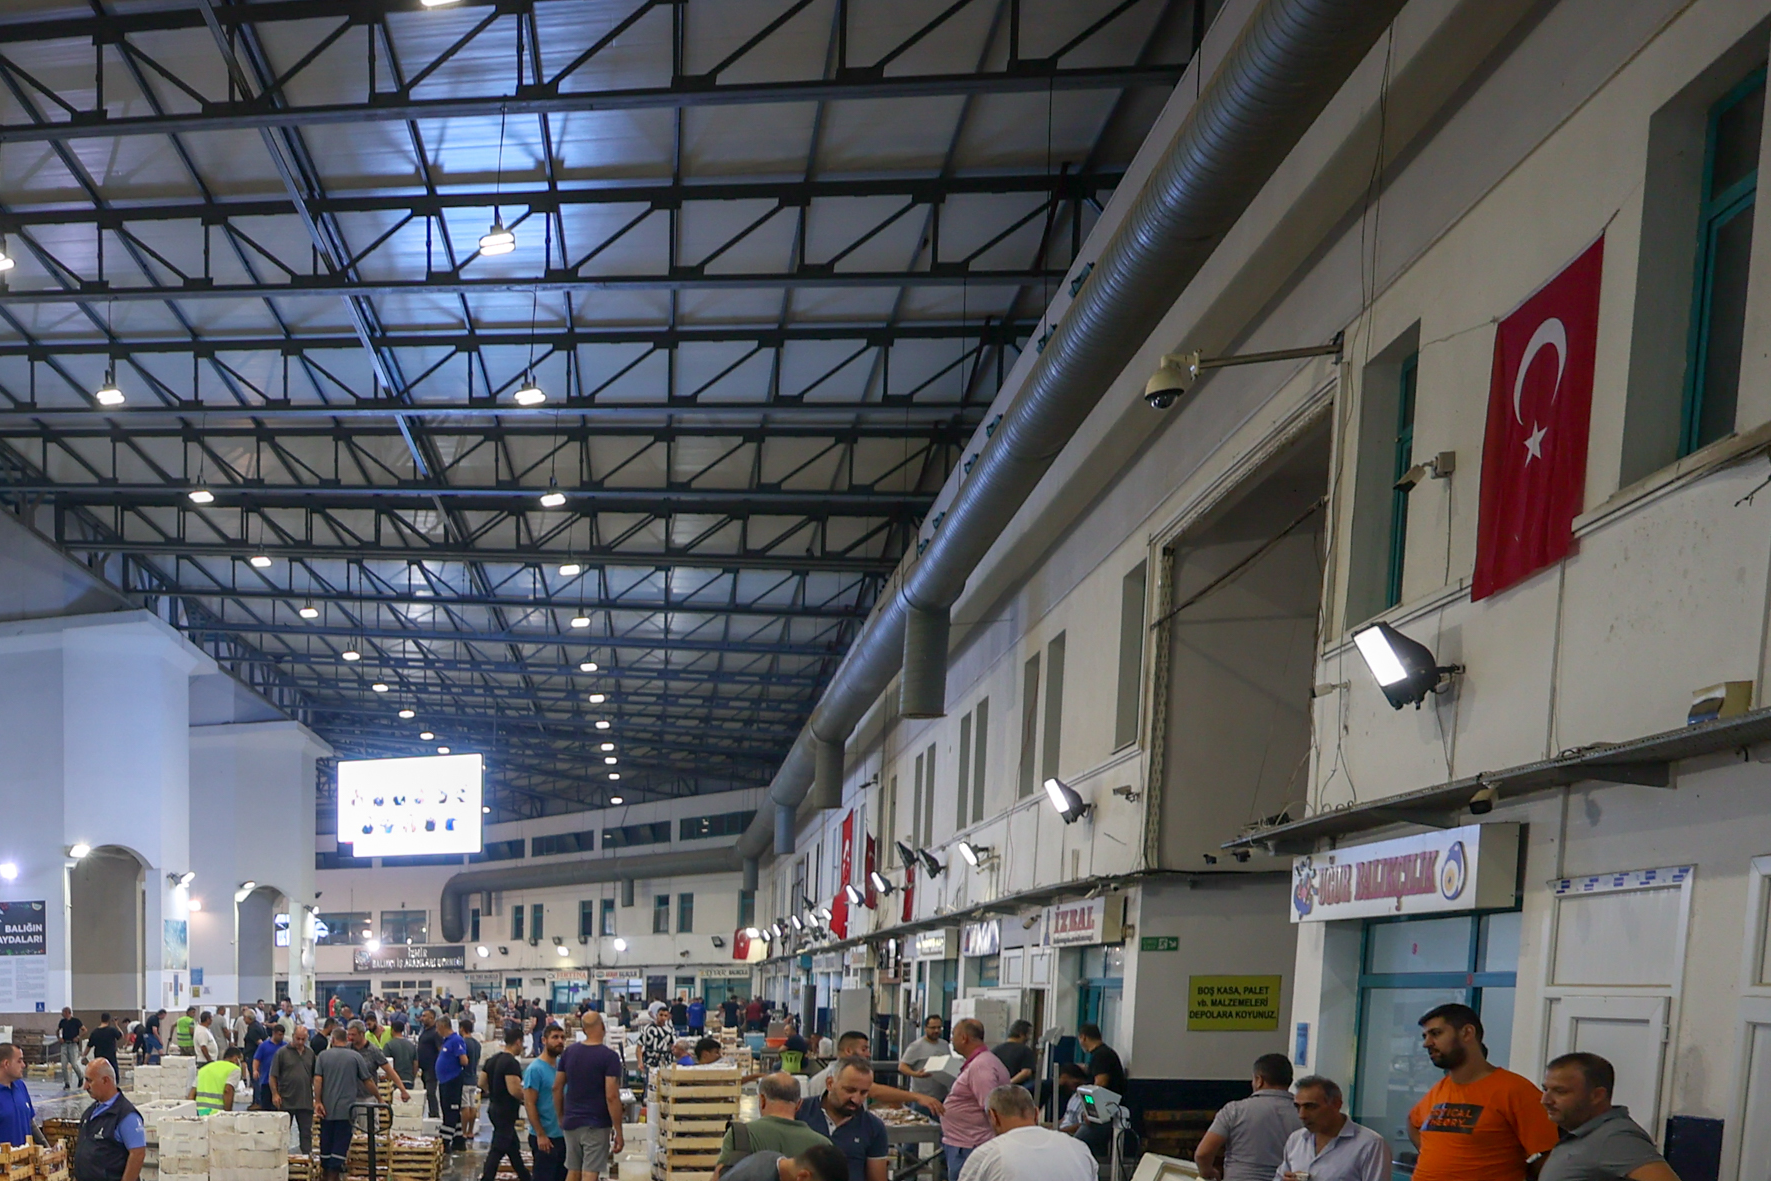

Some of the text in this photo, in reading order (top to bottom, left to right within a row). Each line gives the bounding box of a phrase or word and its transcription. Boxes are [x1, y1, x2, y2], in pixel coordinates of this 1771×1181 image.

[1318, 851, 1439, 911] UĞUR BALIKÇILIK
[5, 922, 43, 933] BALIĞIN
[1198, 986, 1269, 995] BOŞ KASA, PALET
[1211, 997, 1269, 1007] MALZEMELERİ
[1189, 1010, 1277, 1019] DEPOLARA KOYUNUZ.
